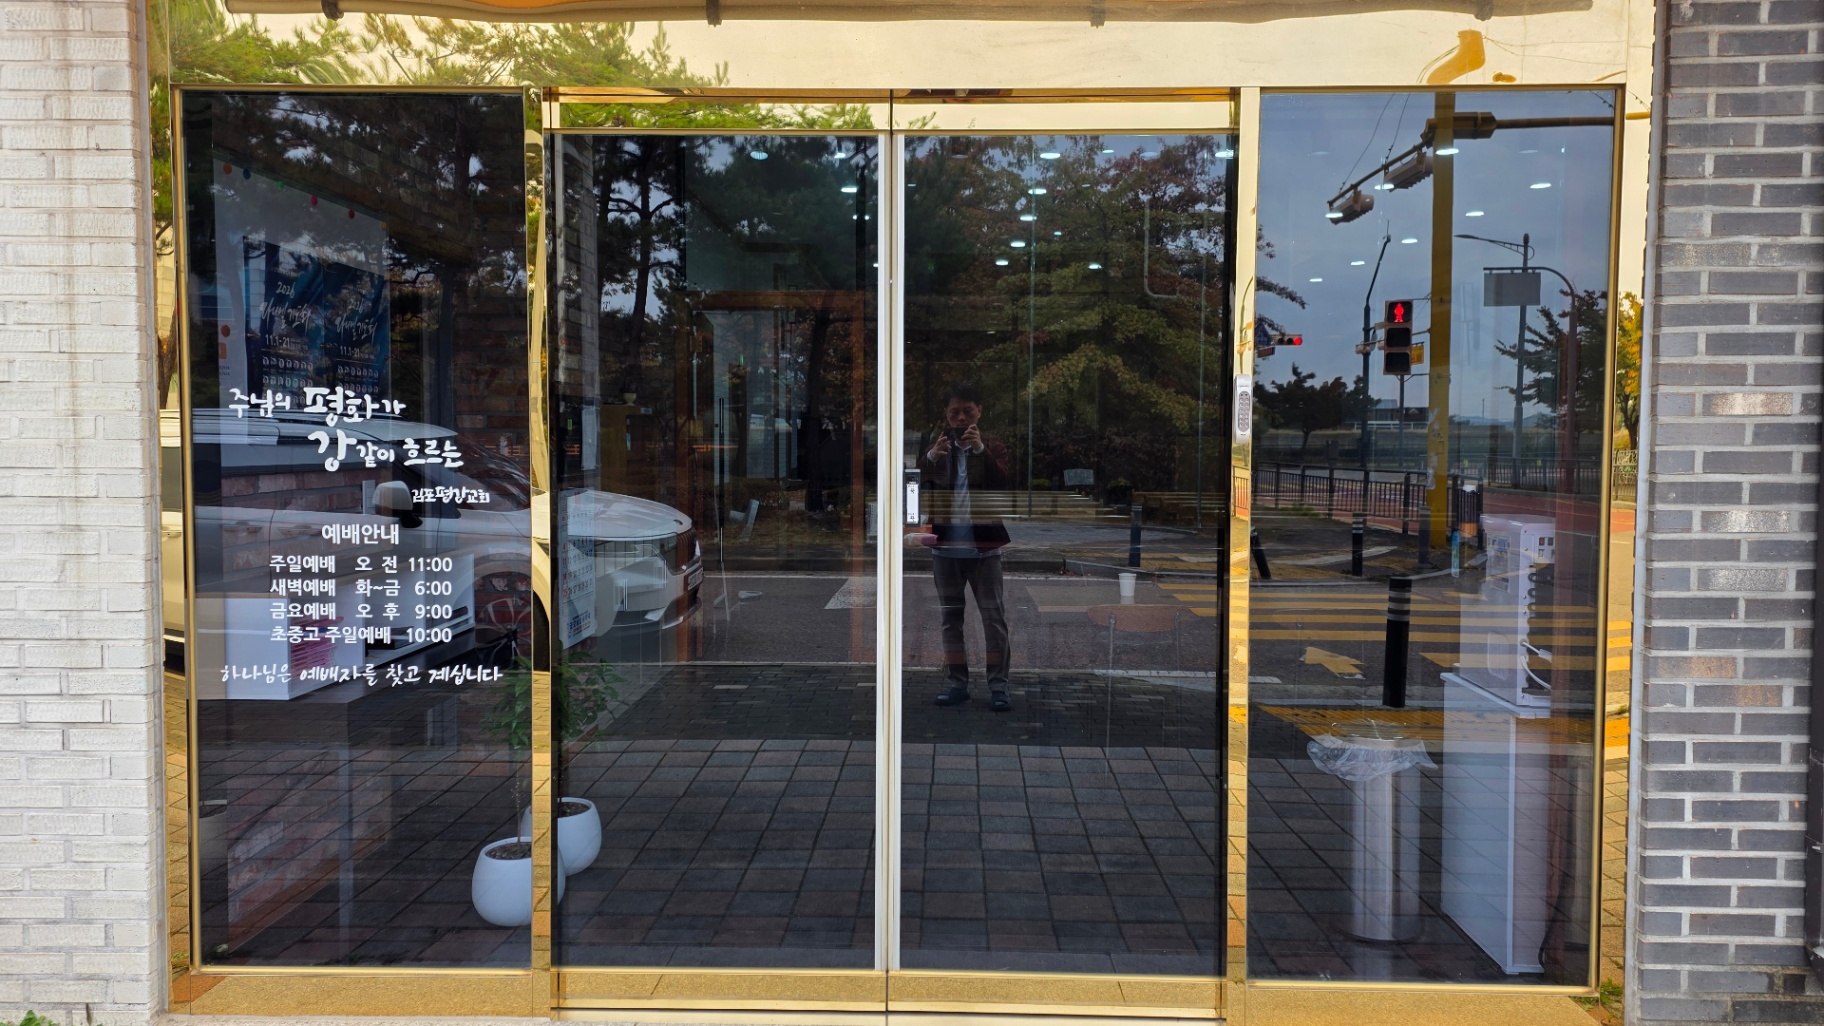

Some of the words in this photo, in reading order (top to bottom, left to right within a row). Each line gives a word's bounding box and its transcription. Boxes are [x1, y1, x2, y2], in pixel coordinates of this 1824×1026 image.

[229, 388, 291, 418] 주님의
[303, 386, 406, 427] 평화가
[402, 437, 464, 468] 흐르는
[411, 485, 490, 504] 김포평강교회
[321, 523, 400, 545] 예배안내
[269, 555, 336, 573] 주일예배
[408, 557, 453, 572] 11:00
[269, 578, 336, 597] 새벽예배
[355, 578, 401, 597] 화~금
[414, 580, 452, 596] 6:00
[269, 602, 337, 620] 금요예배
[414, 604, 453, 619] 9:00
[270, 626, 321, 644] 초중고
[324, 626, 391, 644] 주일예배
[406, 628, 452, 643] 10:00
[220, 664, 292, 684] 하나님은
[300, 664, 378, 686] 예배자를
[386, 663, 421, 687] 찾고
[428, 664, 503, 686] 계십니다
